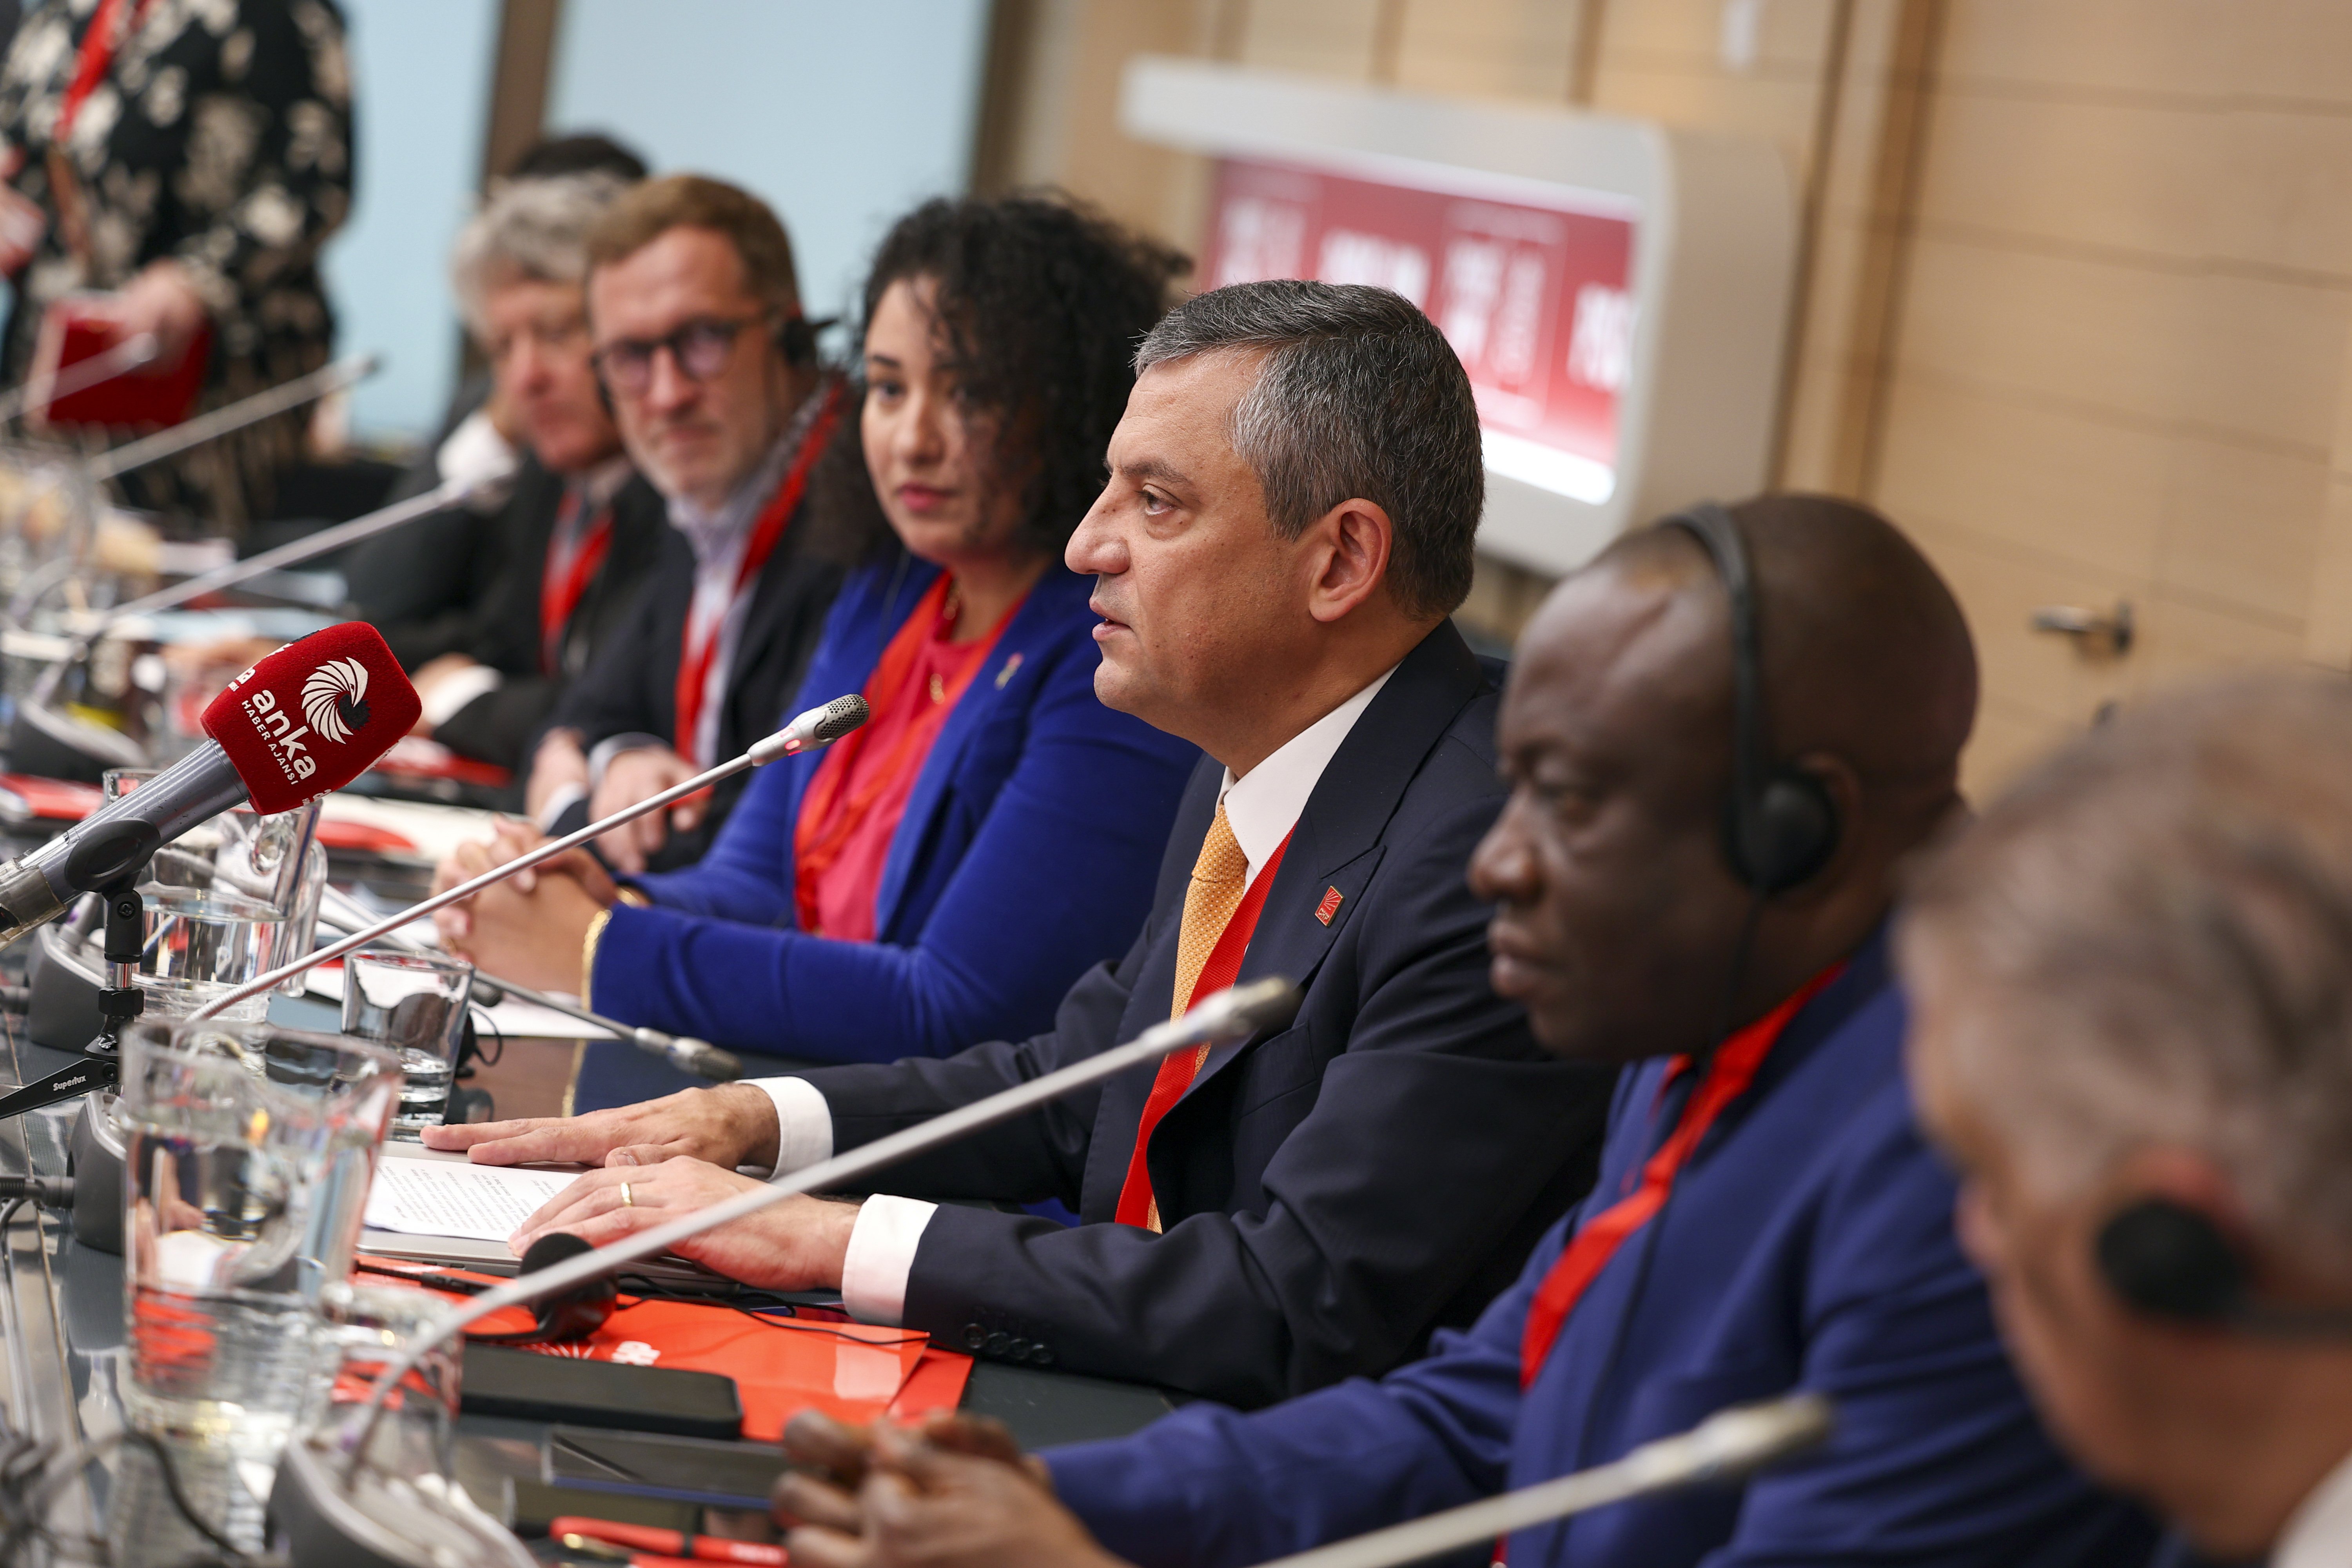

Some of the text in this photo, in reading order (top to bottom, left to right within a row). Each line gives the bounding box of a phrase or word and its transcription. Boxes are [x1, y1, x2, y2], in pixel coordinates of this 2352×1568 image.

[242, 700, 270, 740] HABER
[268, 744, 299, 784] AJANSI
[252, 690, 316, 780] anka
[1318, 908, 1329, 920] CHP
[53, 1075, 86, 1091] Superlux
